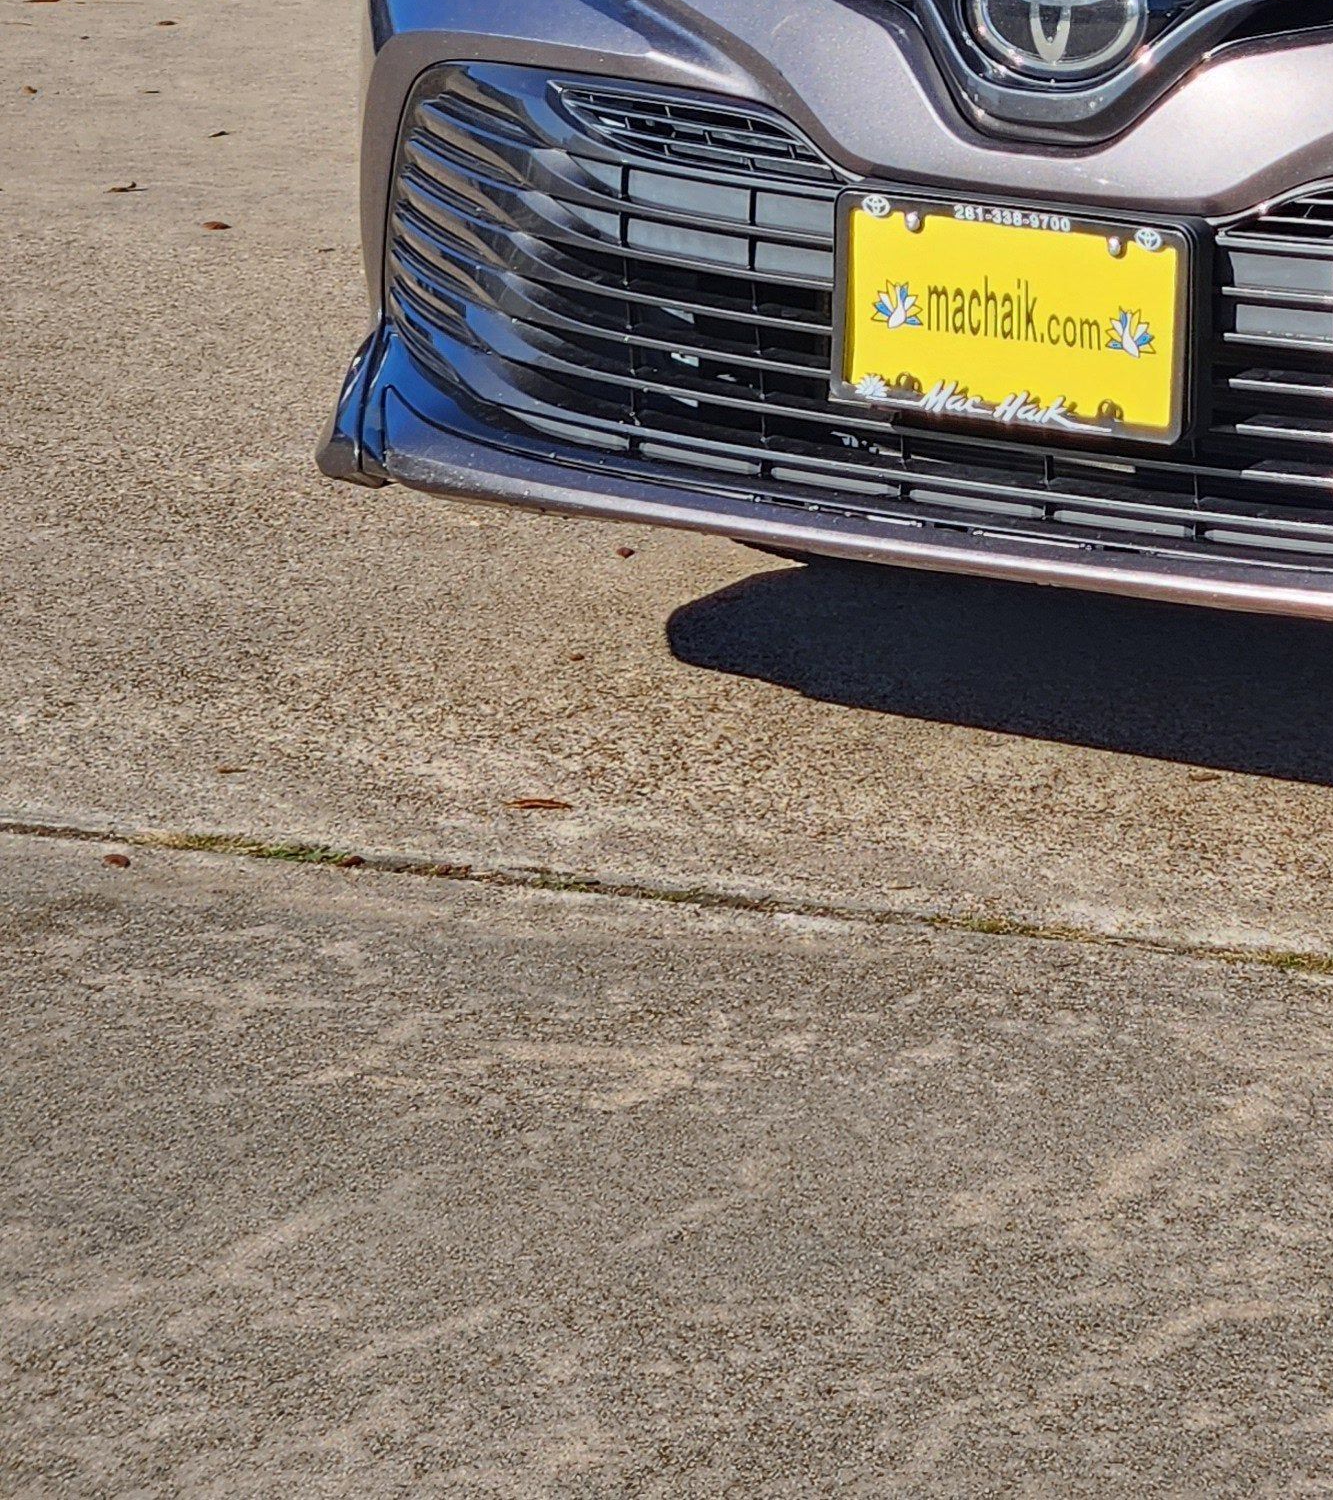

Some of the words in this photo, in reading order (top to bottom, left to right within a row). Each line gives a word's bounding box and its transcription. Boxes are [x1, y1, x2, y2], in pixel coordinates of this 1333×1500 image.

[927, 275, 1102, 351] machaik.com
[918, 378, 992, 415] Mac
[992, 389, 1110, 434] Haik
